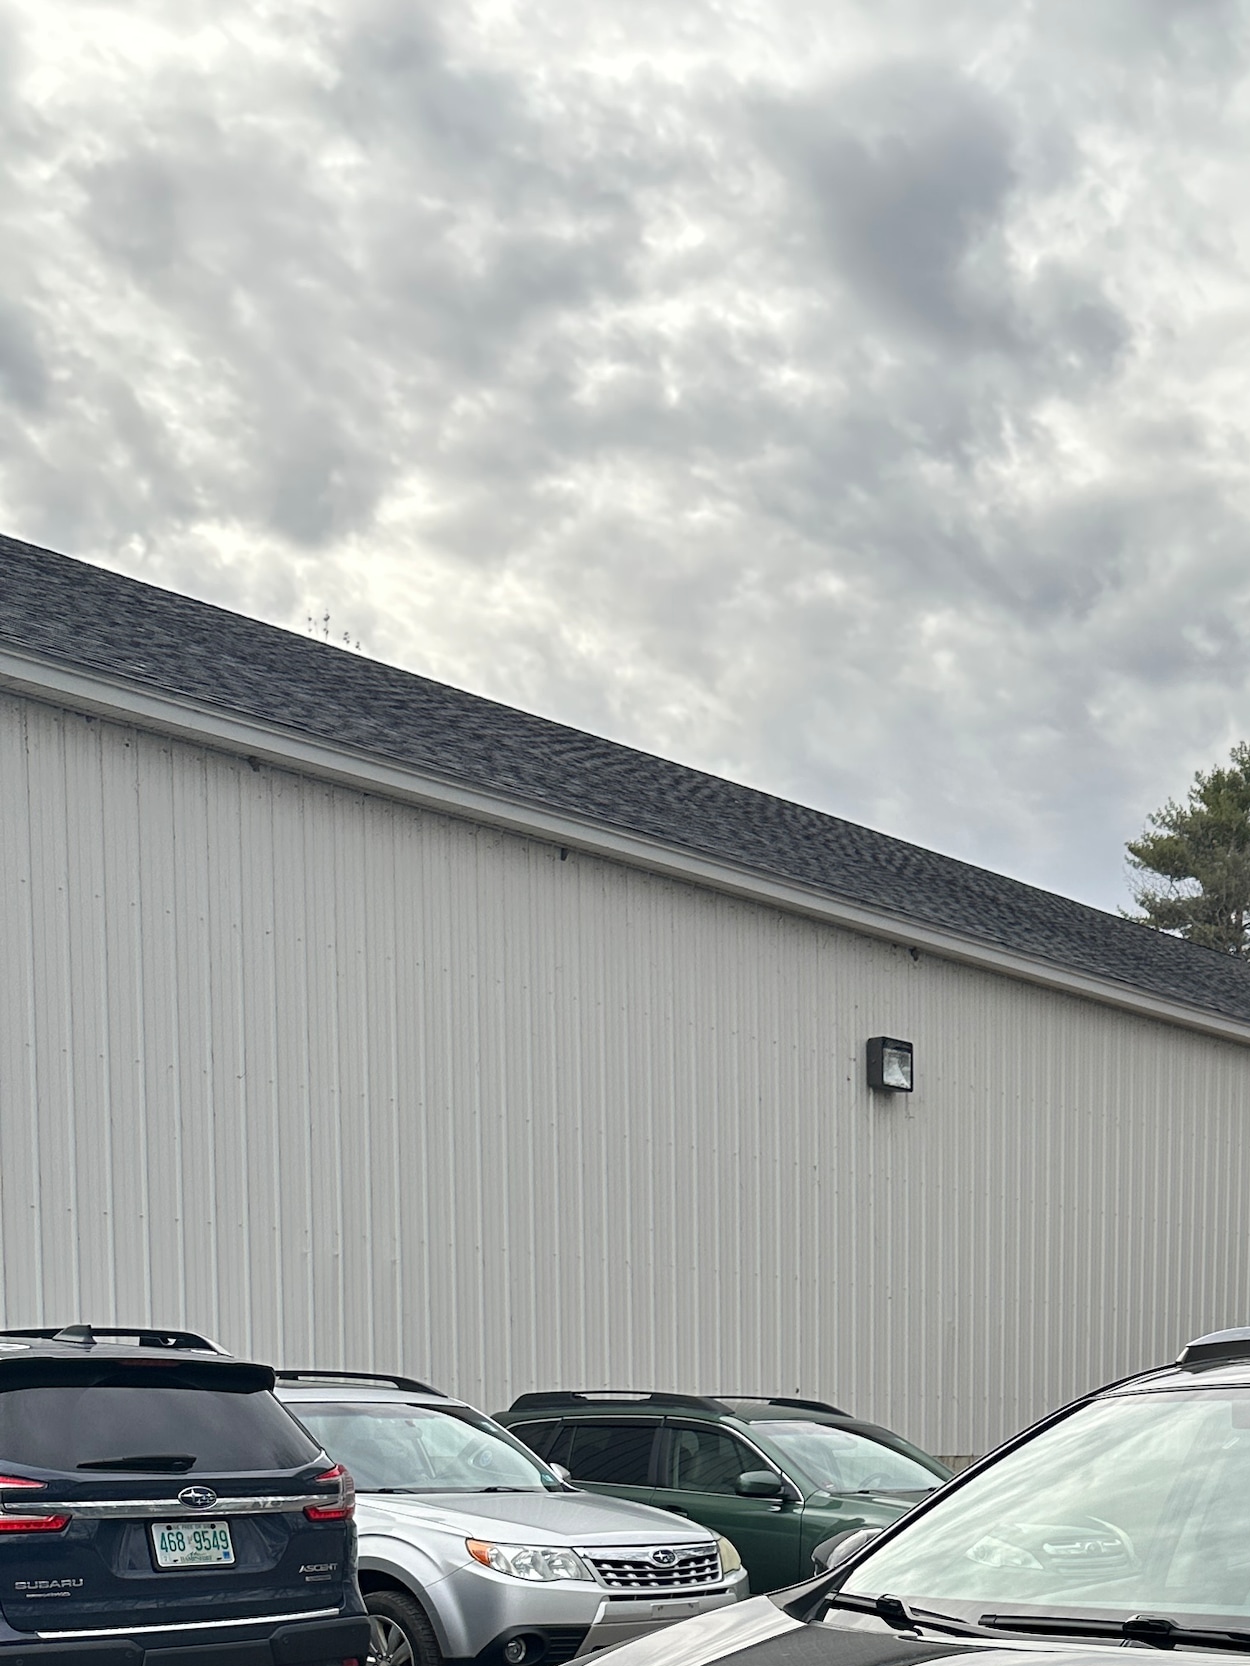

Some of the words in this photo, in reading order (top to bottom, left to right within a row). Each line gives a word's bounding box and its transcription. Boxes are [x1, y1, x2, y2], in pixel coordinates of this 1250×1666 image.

[160, 1531, 186, 1552] 468
[193, 1530, 229, 1551] 9549
[299, 1563, 338, 1573] ASCENT
[14, 1579, 84, 1590] SUBARU
